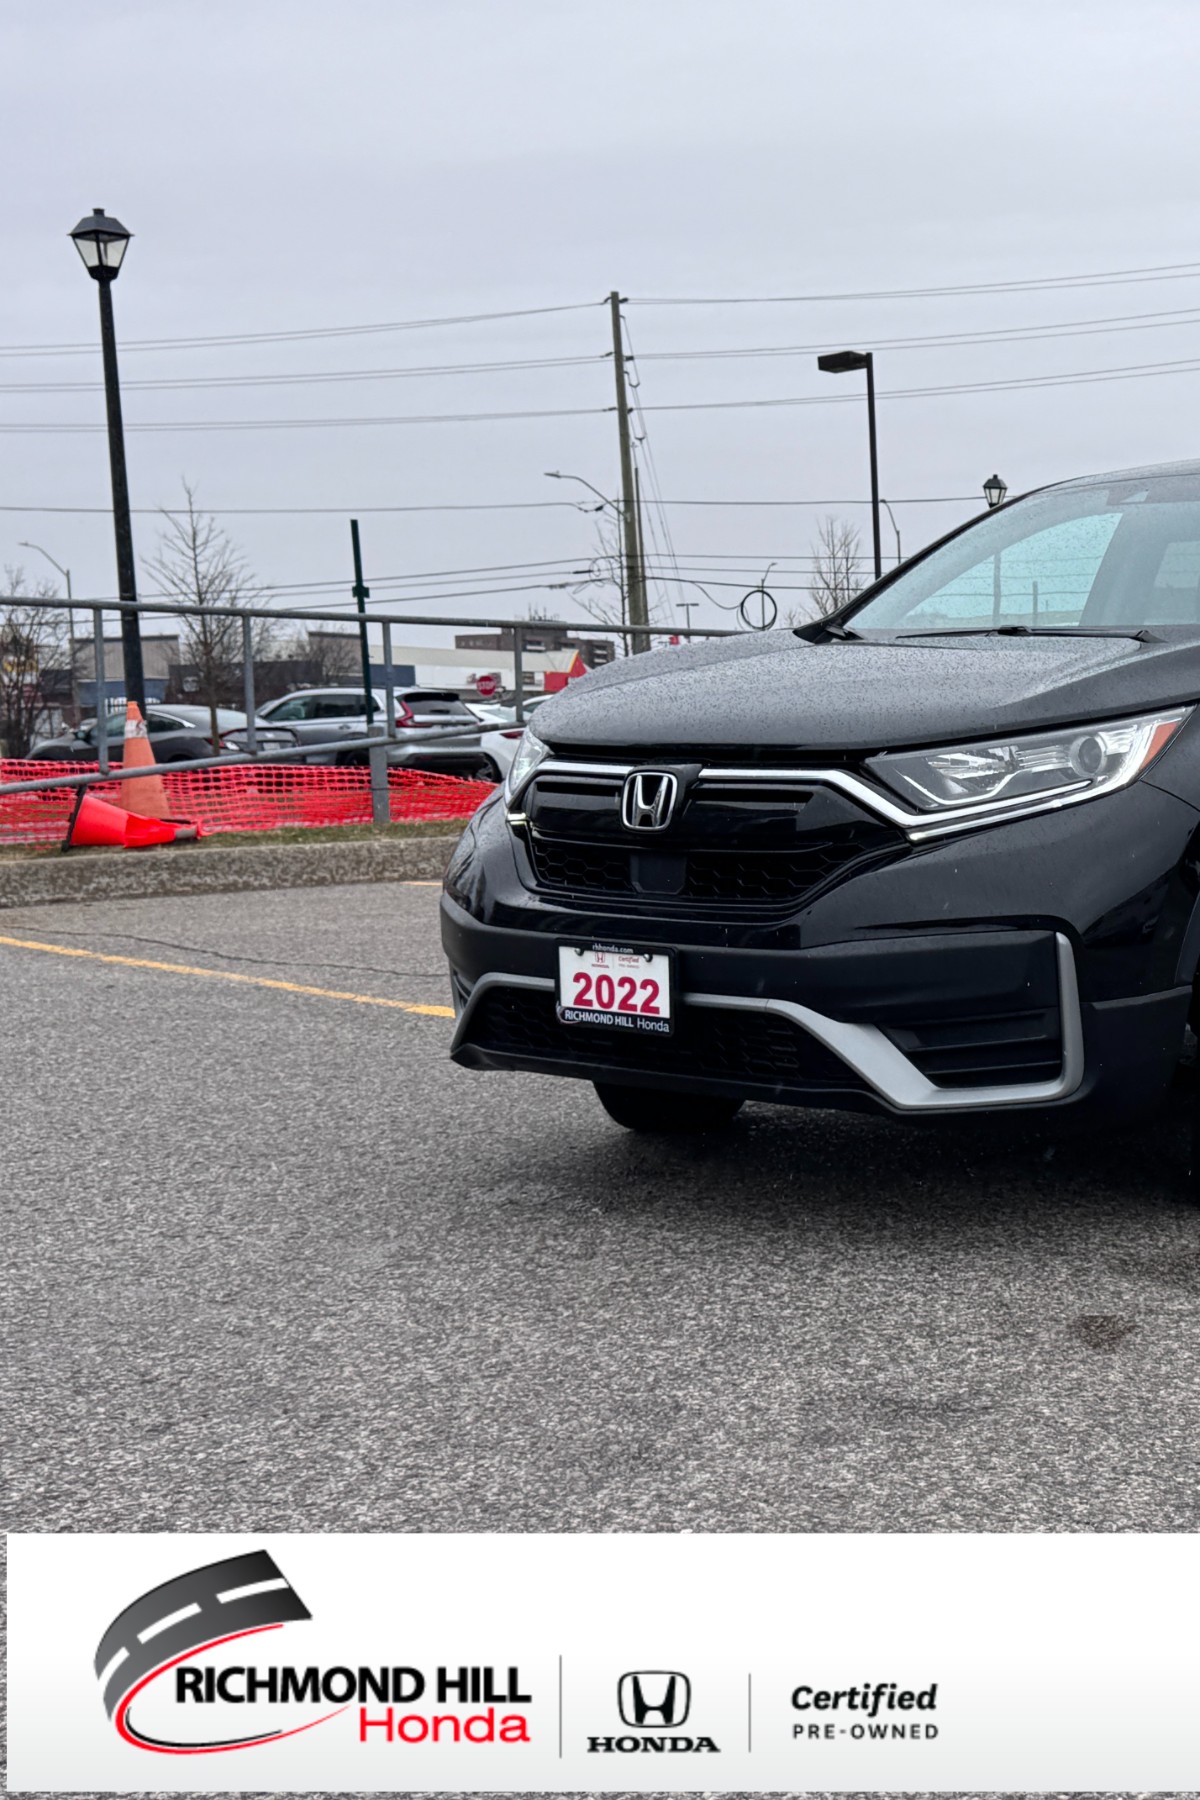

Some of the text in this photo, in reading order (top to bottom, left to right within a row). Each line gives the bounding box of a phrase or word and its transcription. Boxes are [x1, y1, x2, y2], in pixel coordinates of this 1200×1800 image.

[573, 972, 660, 1015] 2022
[564, 1009, 670, 1033] RICHMOND HILL Honda
